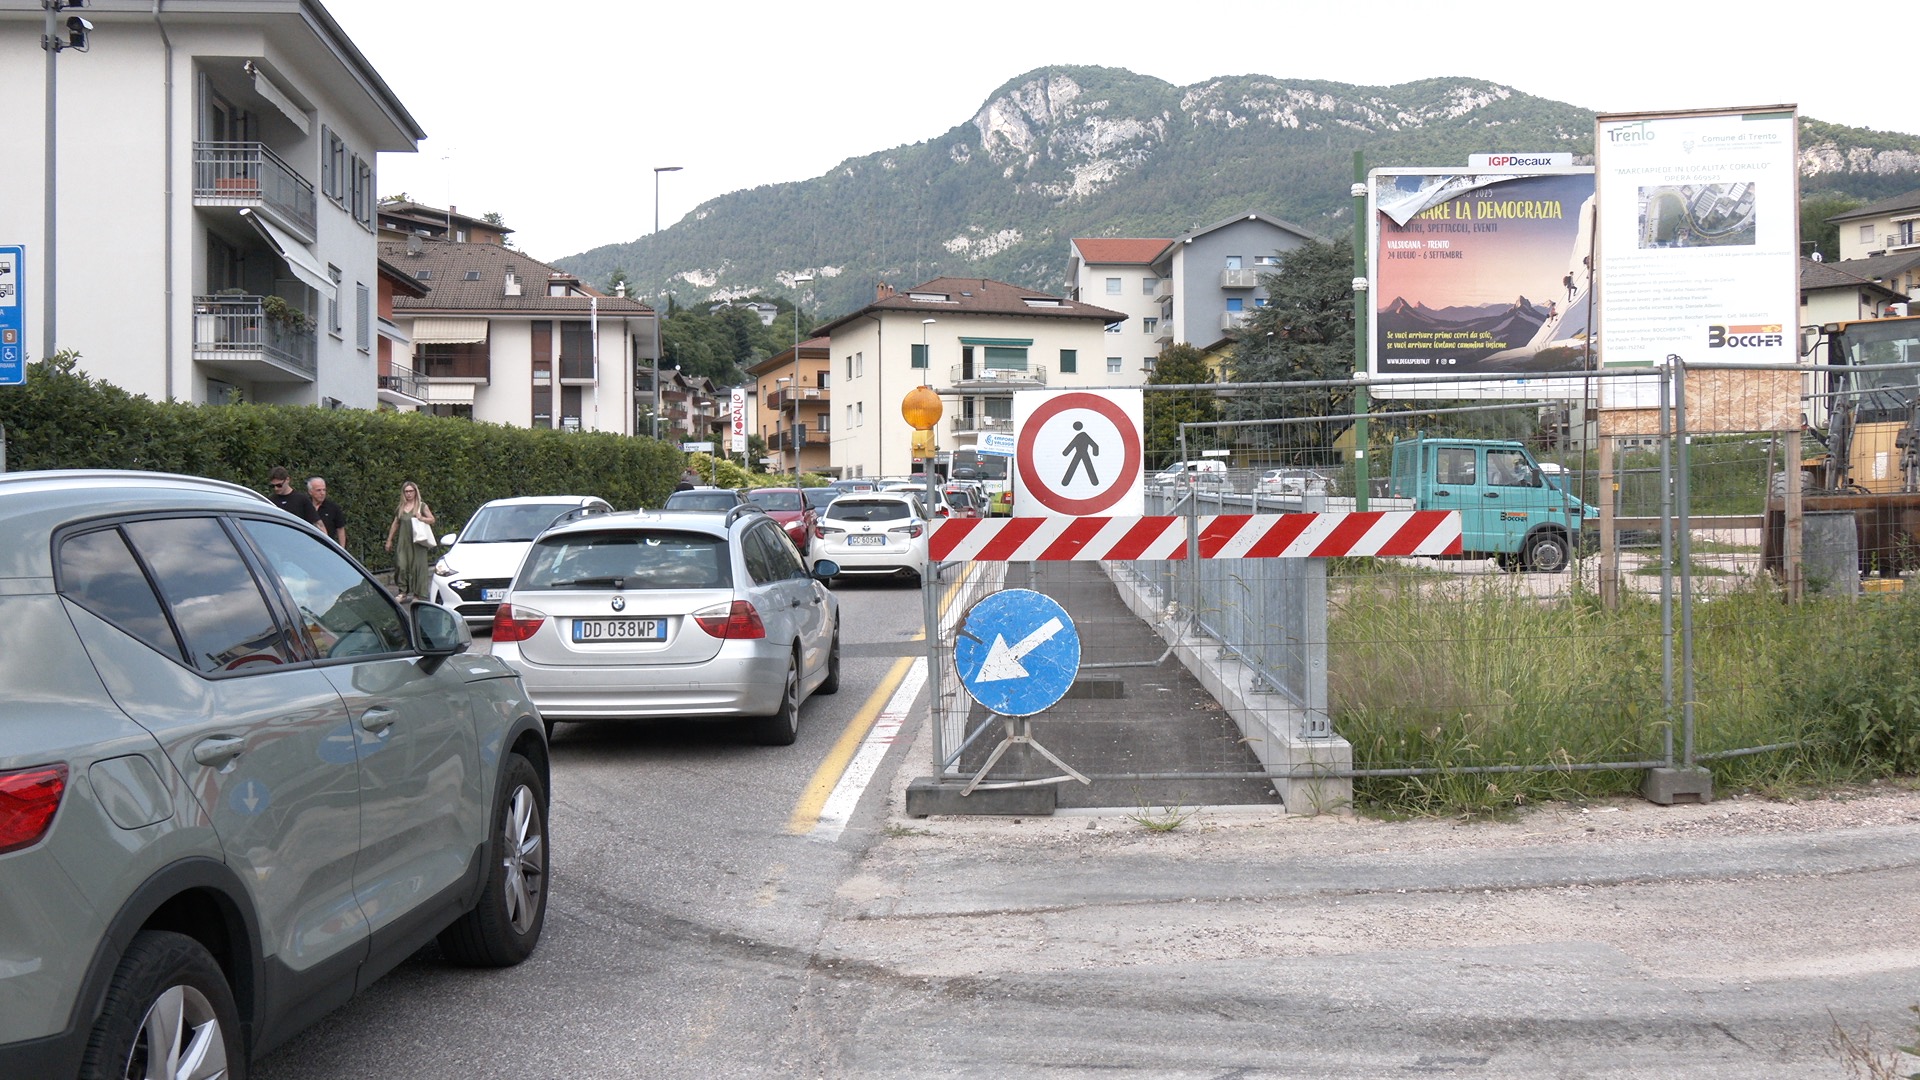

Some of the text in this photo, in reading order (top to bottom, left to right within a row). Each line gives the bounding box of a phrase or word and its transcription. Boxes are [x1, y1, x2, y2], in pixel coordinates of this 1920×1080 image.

[1607, 121, 1655, 142] Trento
[1702, 135, 1735, 143] Comune
[1748, 132, 1777, 140] Trento
[1488, 156, 1552, 167] IGPDecaux
[1675, 165, 1684, 173] IN
[1475, 188, 1493, 198] 2025
[1456, 200, 1472, 219] LA
[1478, 200, 1562, 219] DEMOCRAZIA
[1427, 223, 1470, 234] SPETTACOLI,
[1473, 223, 1498, 233] EVENTI
[1387, 240, 1421, 249] VALSUGANA
[1427, 240, 1450, 249] TRENTO
[1387, 251, 1395, 259] 24
[1423, 251, 1428, 259] 6
[1429, 250, 1463, 259] SETTEMBRE
[6, 332, 13, 341] 9
[1387, 331, 1394, 339] Se
[1395, 331, 1408, 339] vuoi
[1408, 331, 1436, 339] arrivare
[1435, 331, 1453, 341] primo
[1454, 331, 1469, 339] corri
[1470, 331, 1478, 339] da
[1709, 325, 1783, 348] BOCCHER
[1394, 341, 1407, 349] vuoi
[1407, 341, 1433, 349] arrivare
[1434, 341, 1456, 349] lontano
[1457, 341, 1485, 349] cammina
[1486, 341, 1507, 350] insieme
[733, 393, 744, 436] KORALLO
[583, 621, 656, 638] DD 038WP
